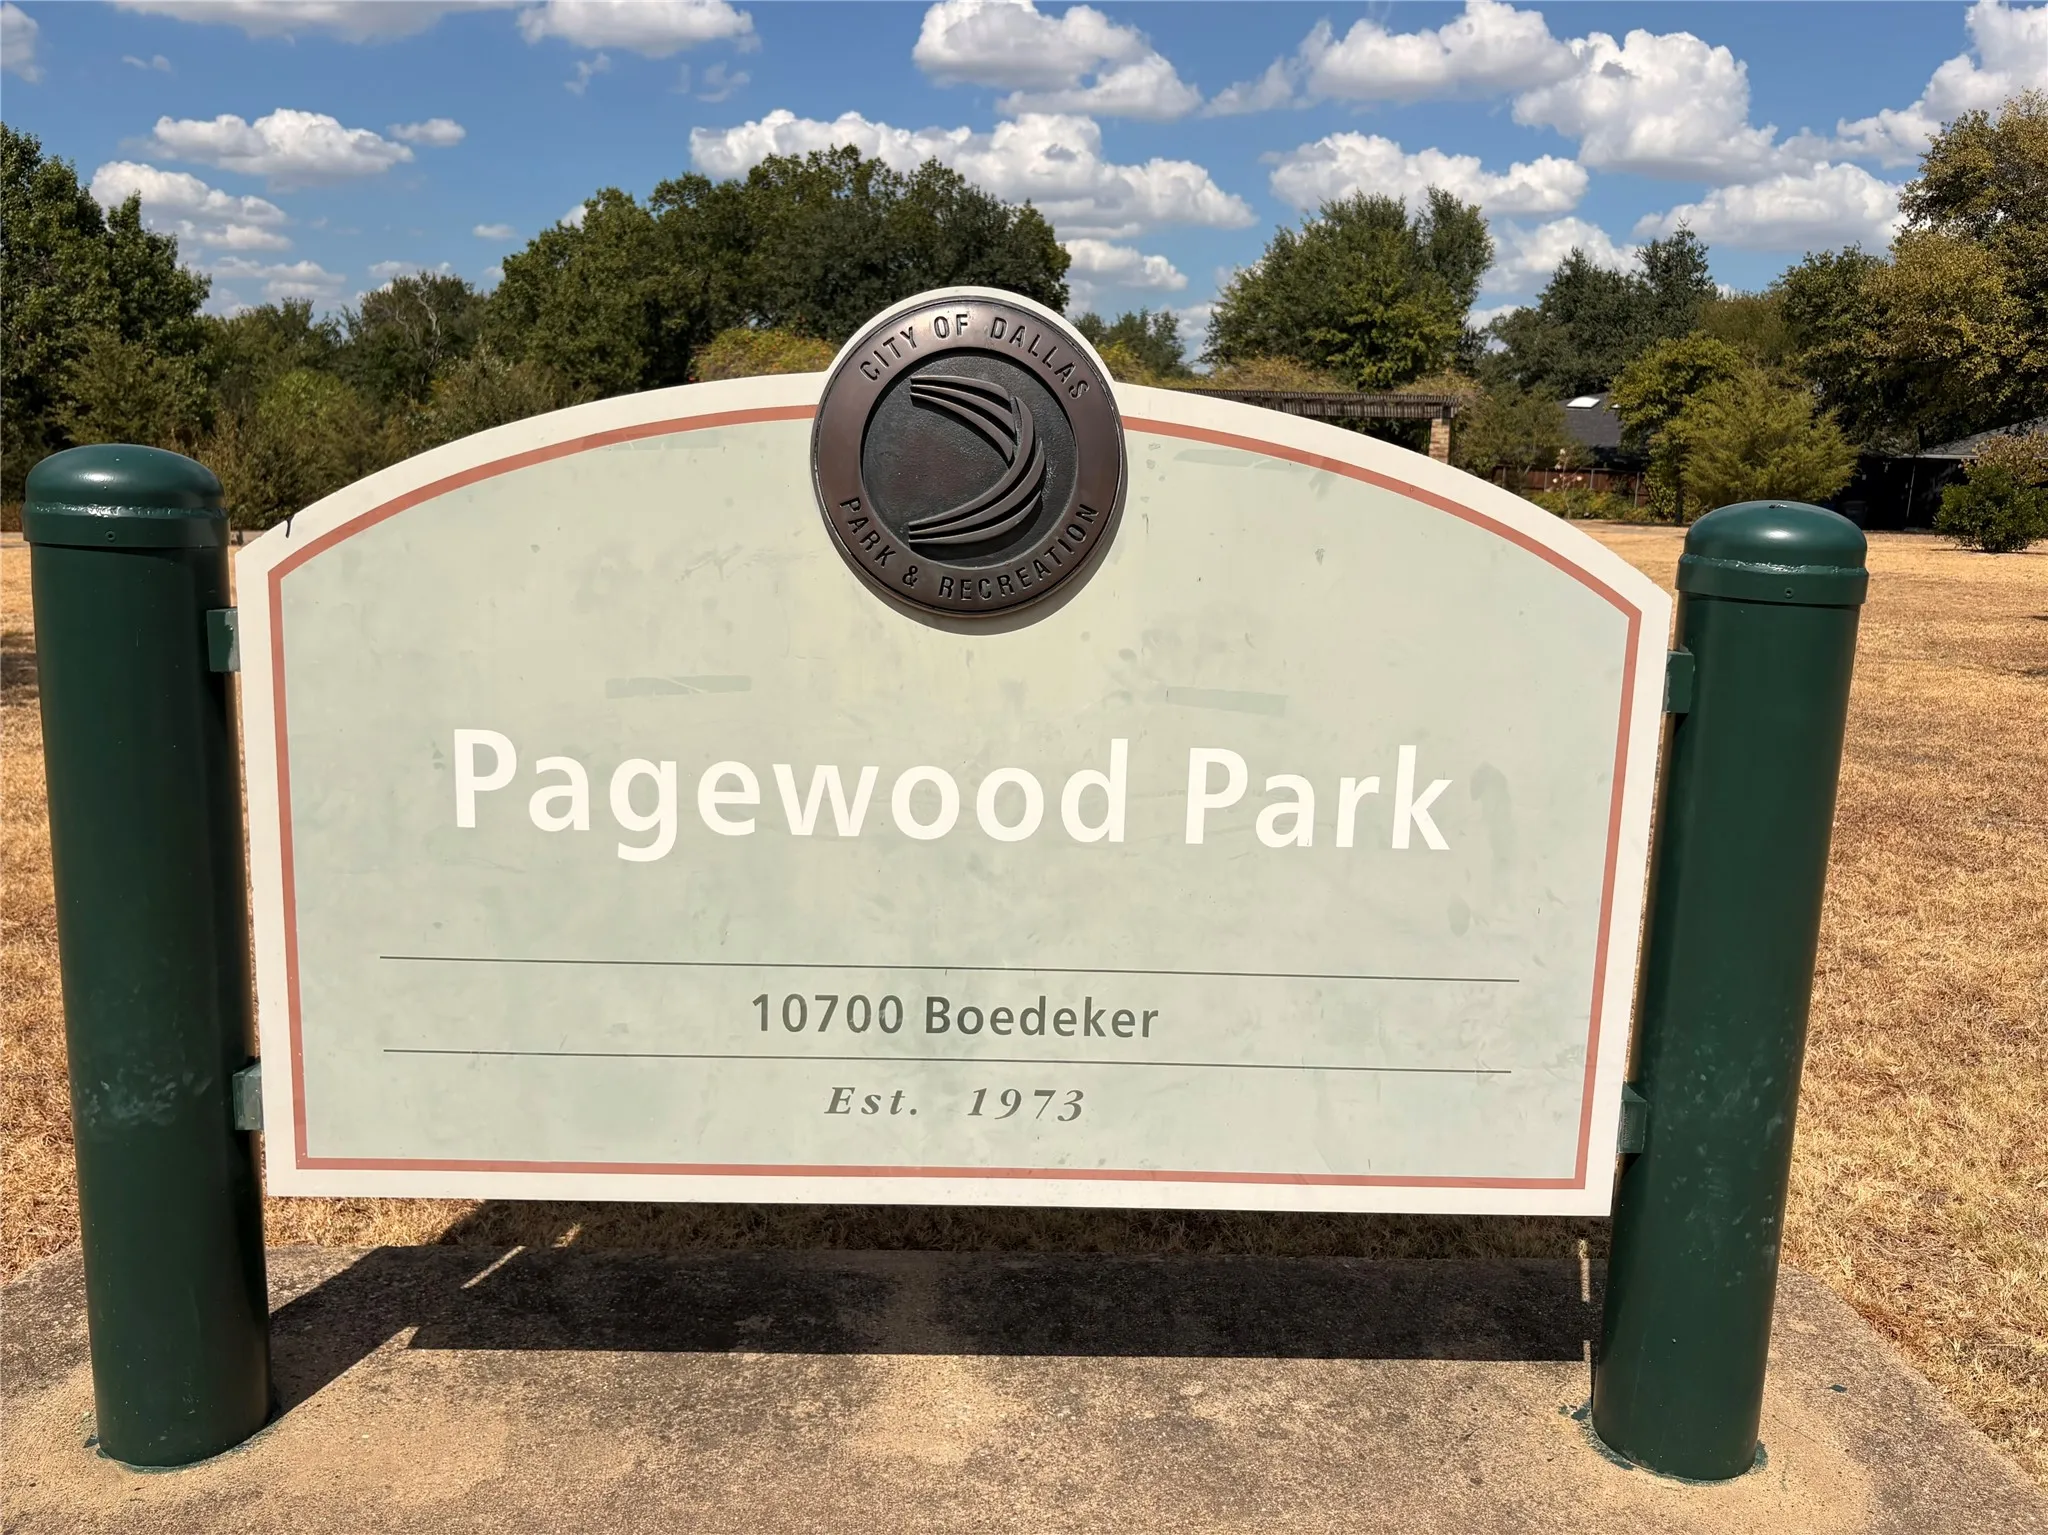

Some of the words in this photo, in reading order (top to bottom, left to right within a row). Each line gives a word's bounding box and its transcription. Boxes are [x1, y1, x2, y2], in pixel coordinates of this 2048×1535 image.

[859, 326, 918, 382] CITY
[933, 313, 969, 340] OF
[989, 316, 1090, 400] DALLAS
[840, 496, 898, 569] PARK
[902, 565, 919, 587] &
[938, 503, 1100, 600] RECREATION
[453, 728, 1129, 862] Pagewood
[1185, 744, 1454, 851] Park
[752, 993, 904, 1034] 10700
[924, 995, 1159, 1038] Boedeker
[824, 1086, 918, 1116] Est.
[967, 1087, 1085, 1122] 1973
